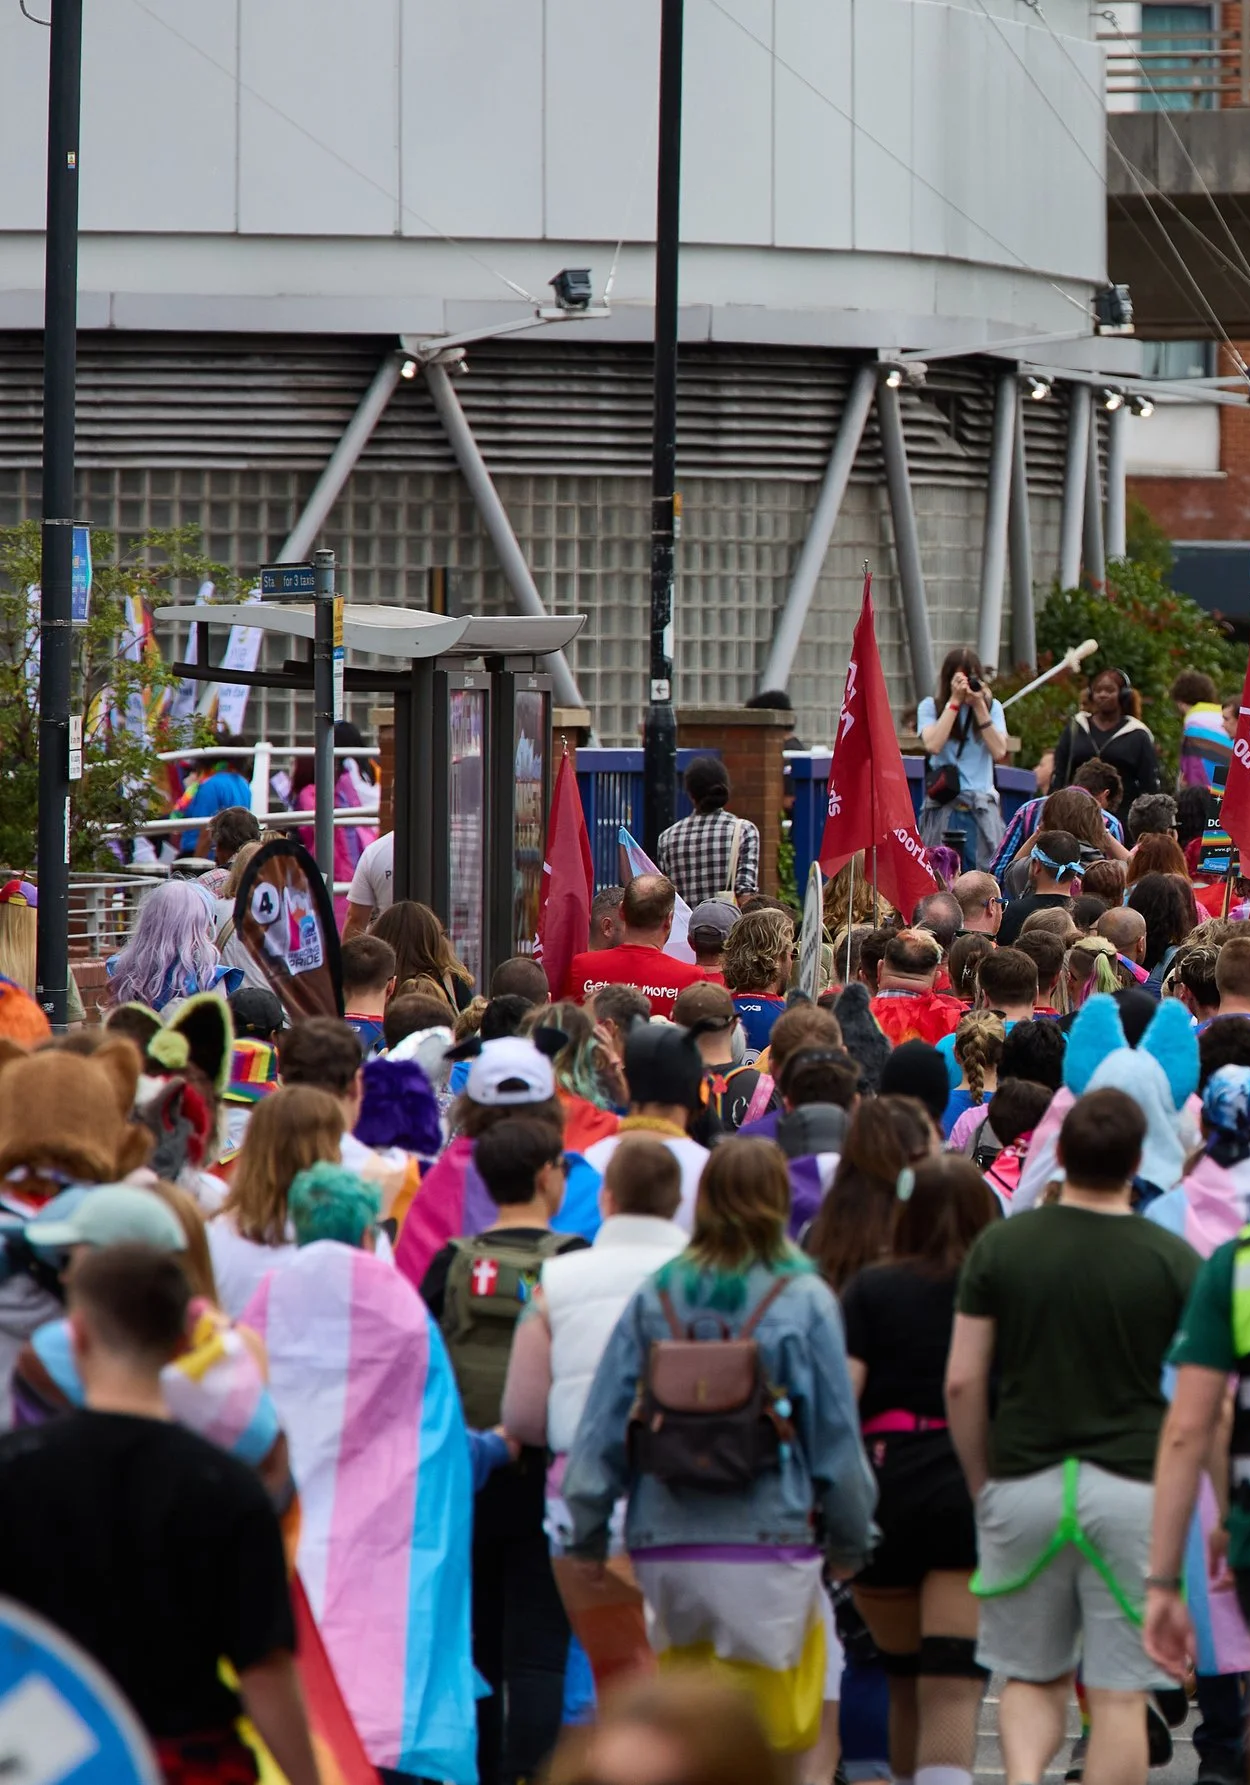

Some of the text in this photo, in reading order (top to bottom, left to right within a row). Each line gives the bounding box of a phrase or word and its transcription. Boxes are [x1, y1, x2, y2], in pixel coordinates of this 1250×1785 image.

[283, 575, 293, 587] for
[293, 574, 299, 586] 3
[300, 573, 315, 586] taxis
[258, 891, 274, 915] 4
[289, 952, 321, 968] PRIDE
[642, 984, 679, 1001] more!
